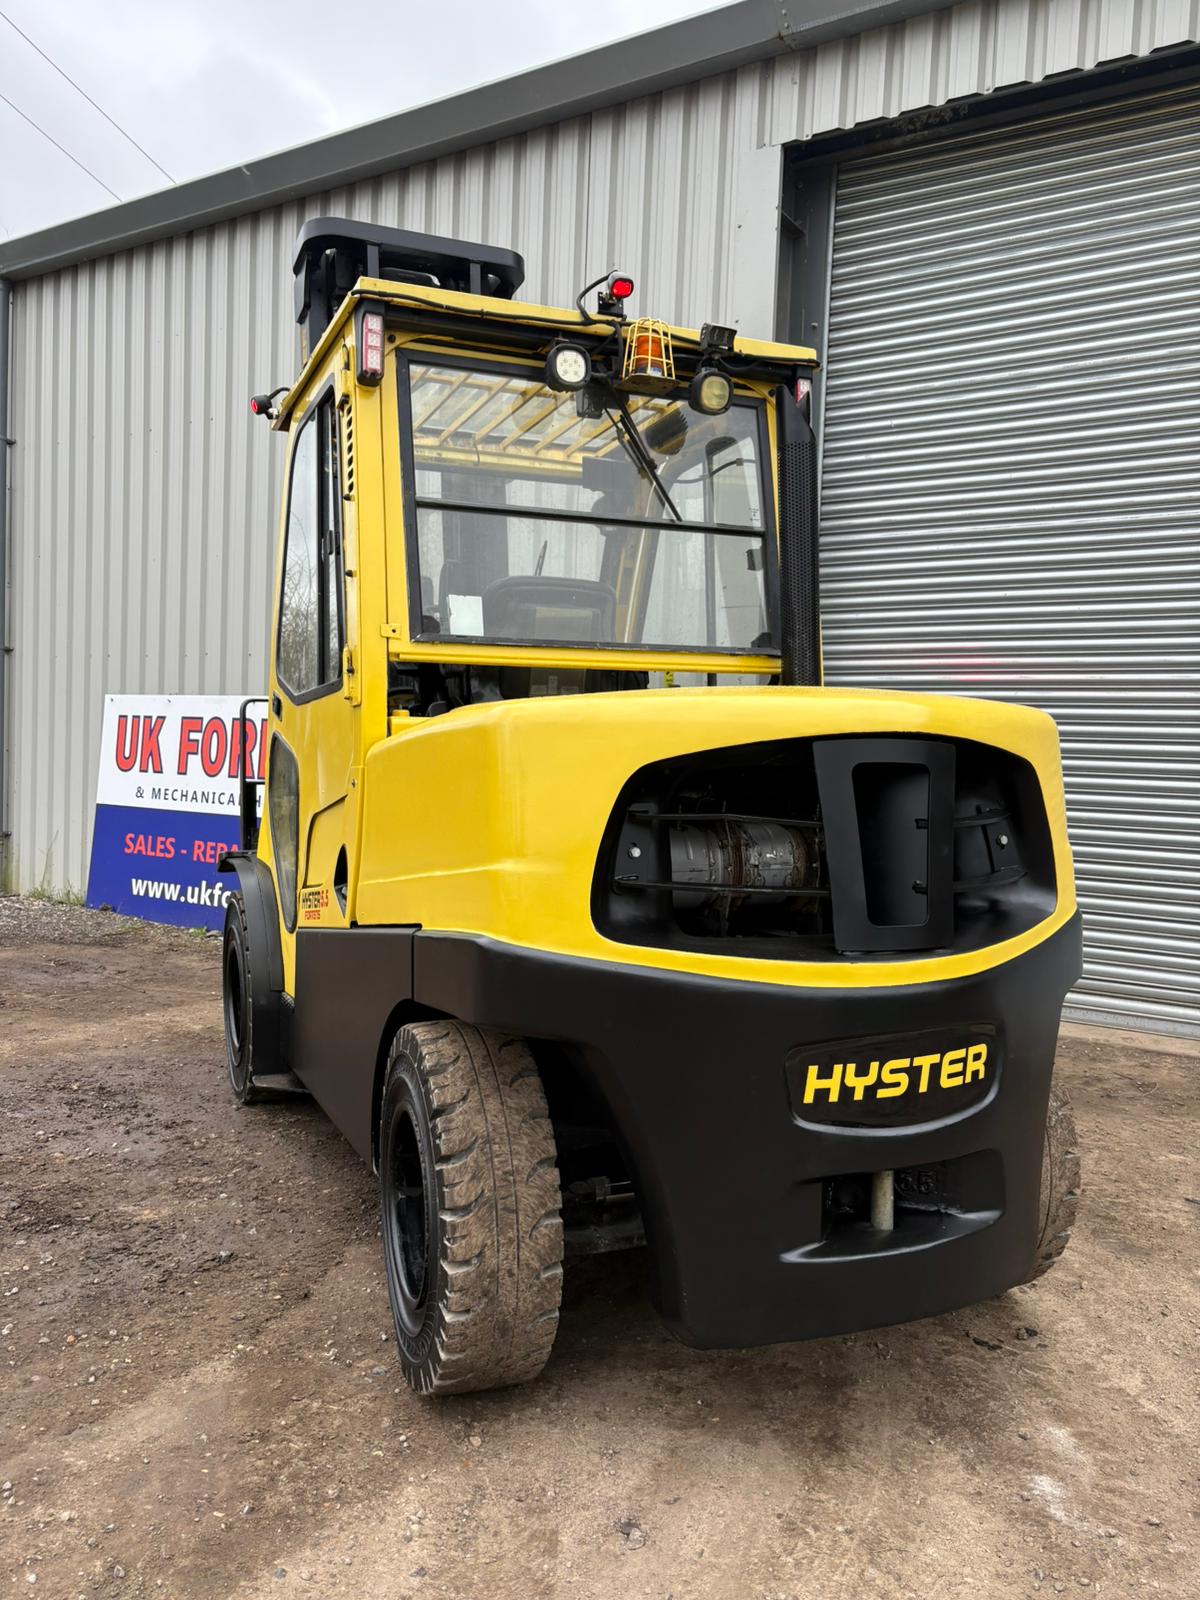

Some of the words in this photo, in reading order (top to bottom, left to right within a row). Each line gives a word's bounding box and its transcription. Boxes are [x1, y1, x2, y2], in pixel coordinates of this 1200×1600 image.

[115, 714, 166, 774] UK
[135, 786, 144, 799] &
[151, 787, 242, 806] MECHANICA
[124, 833, 175, 860] SALES
[803, 1043, 988, 1104] HYSTER
